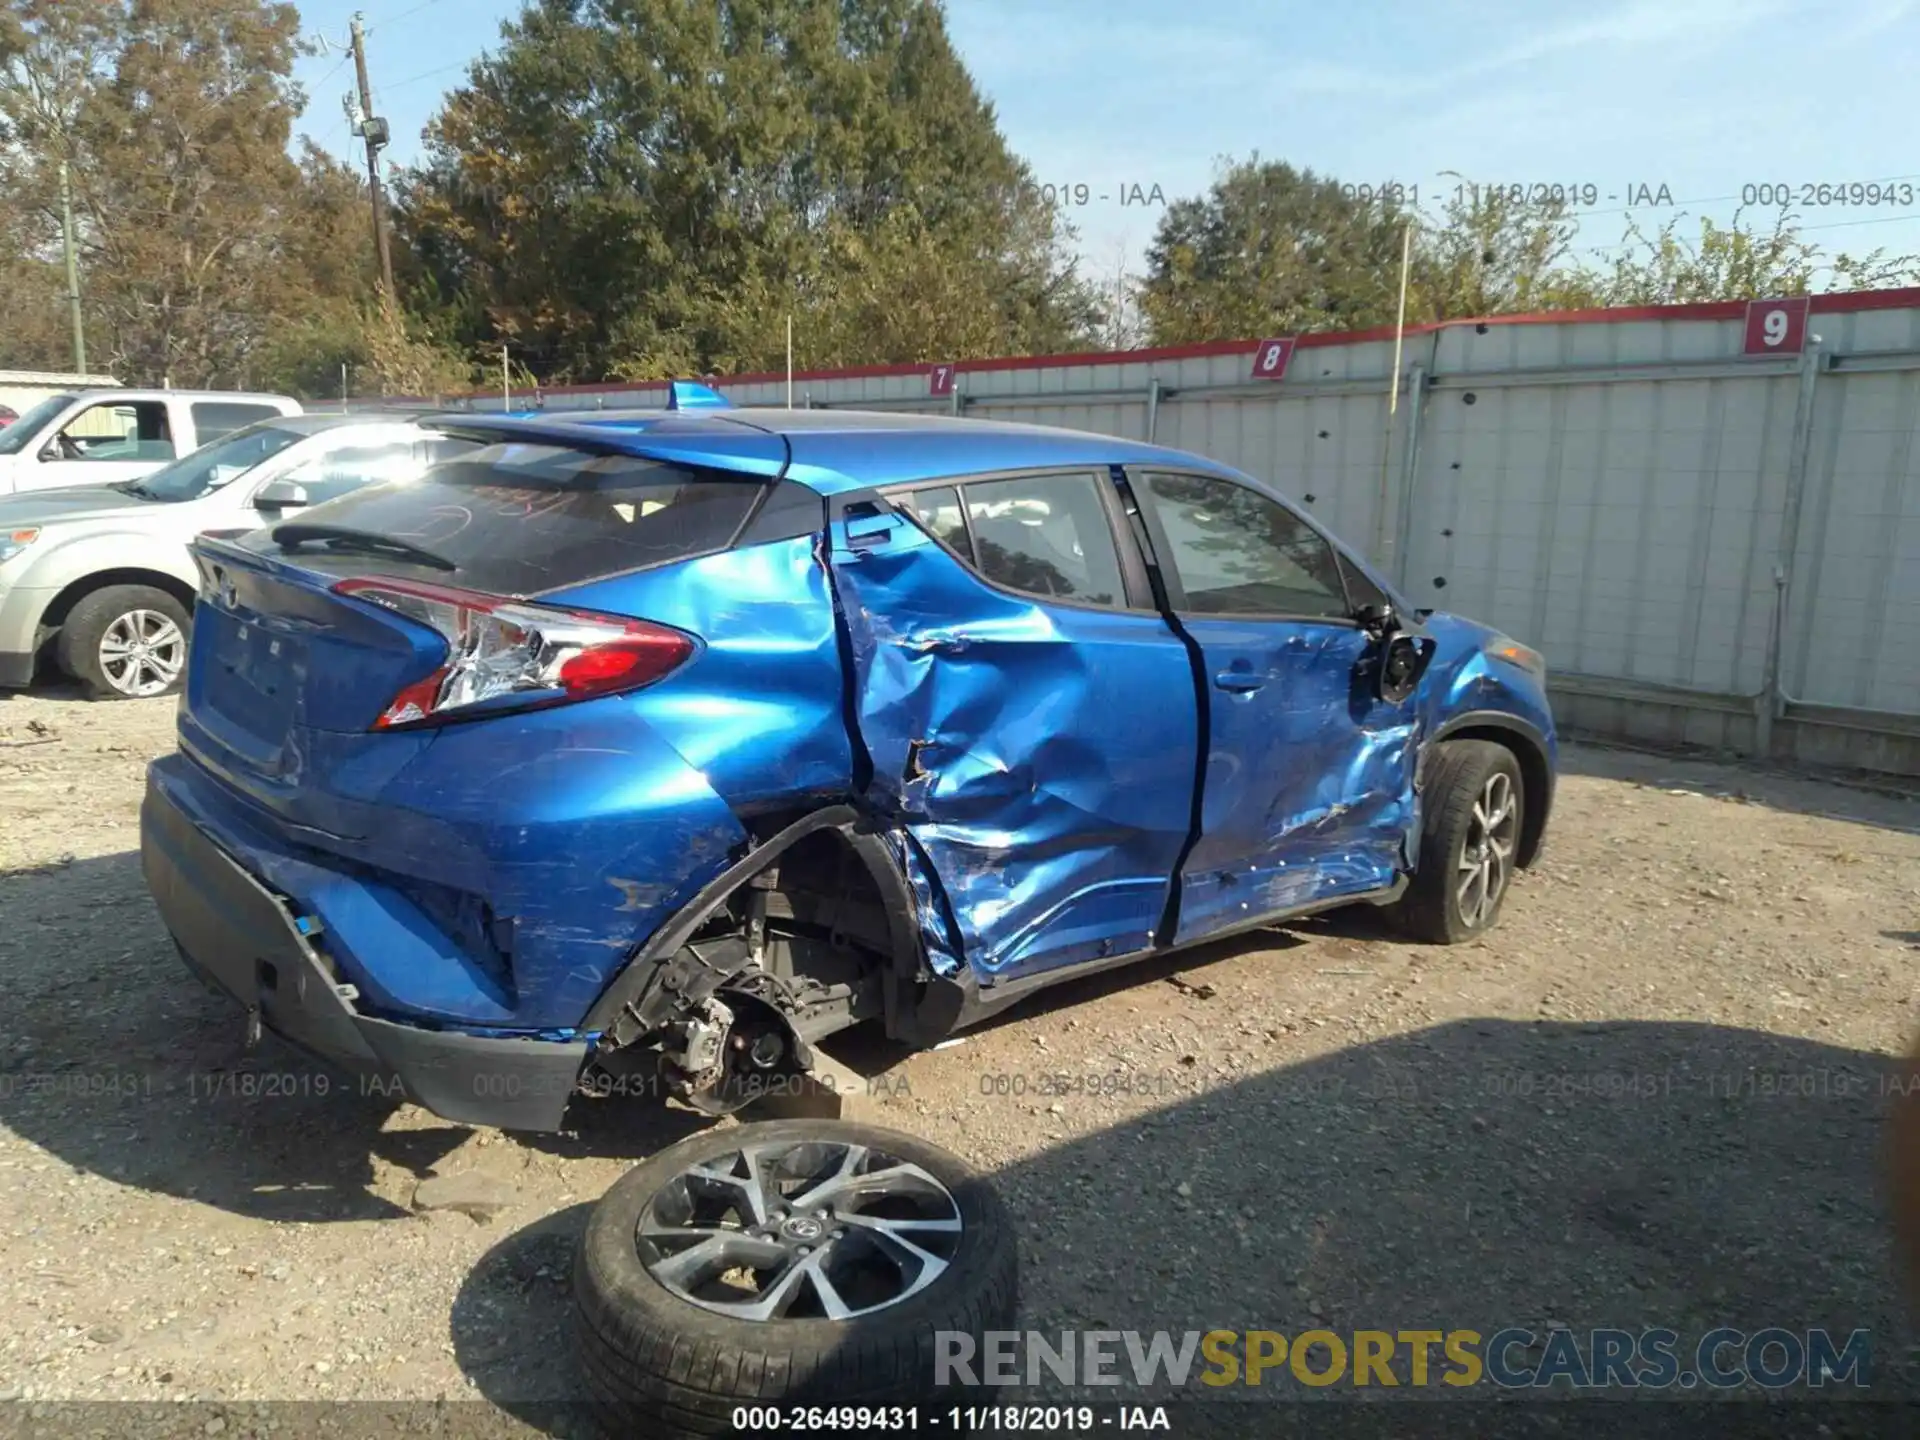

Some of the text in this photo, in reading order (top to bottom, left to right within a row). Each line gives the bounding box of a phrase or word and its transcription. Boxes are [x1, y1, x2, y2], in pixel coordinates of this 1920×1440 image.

[1763, 309, 1788, 347] 9
[1262, 344, 1281, 372] 8
[937, 367, 948, 390] 7
